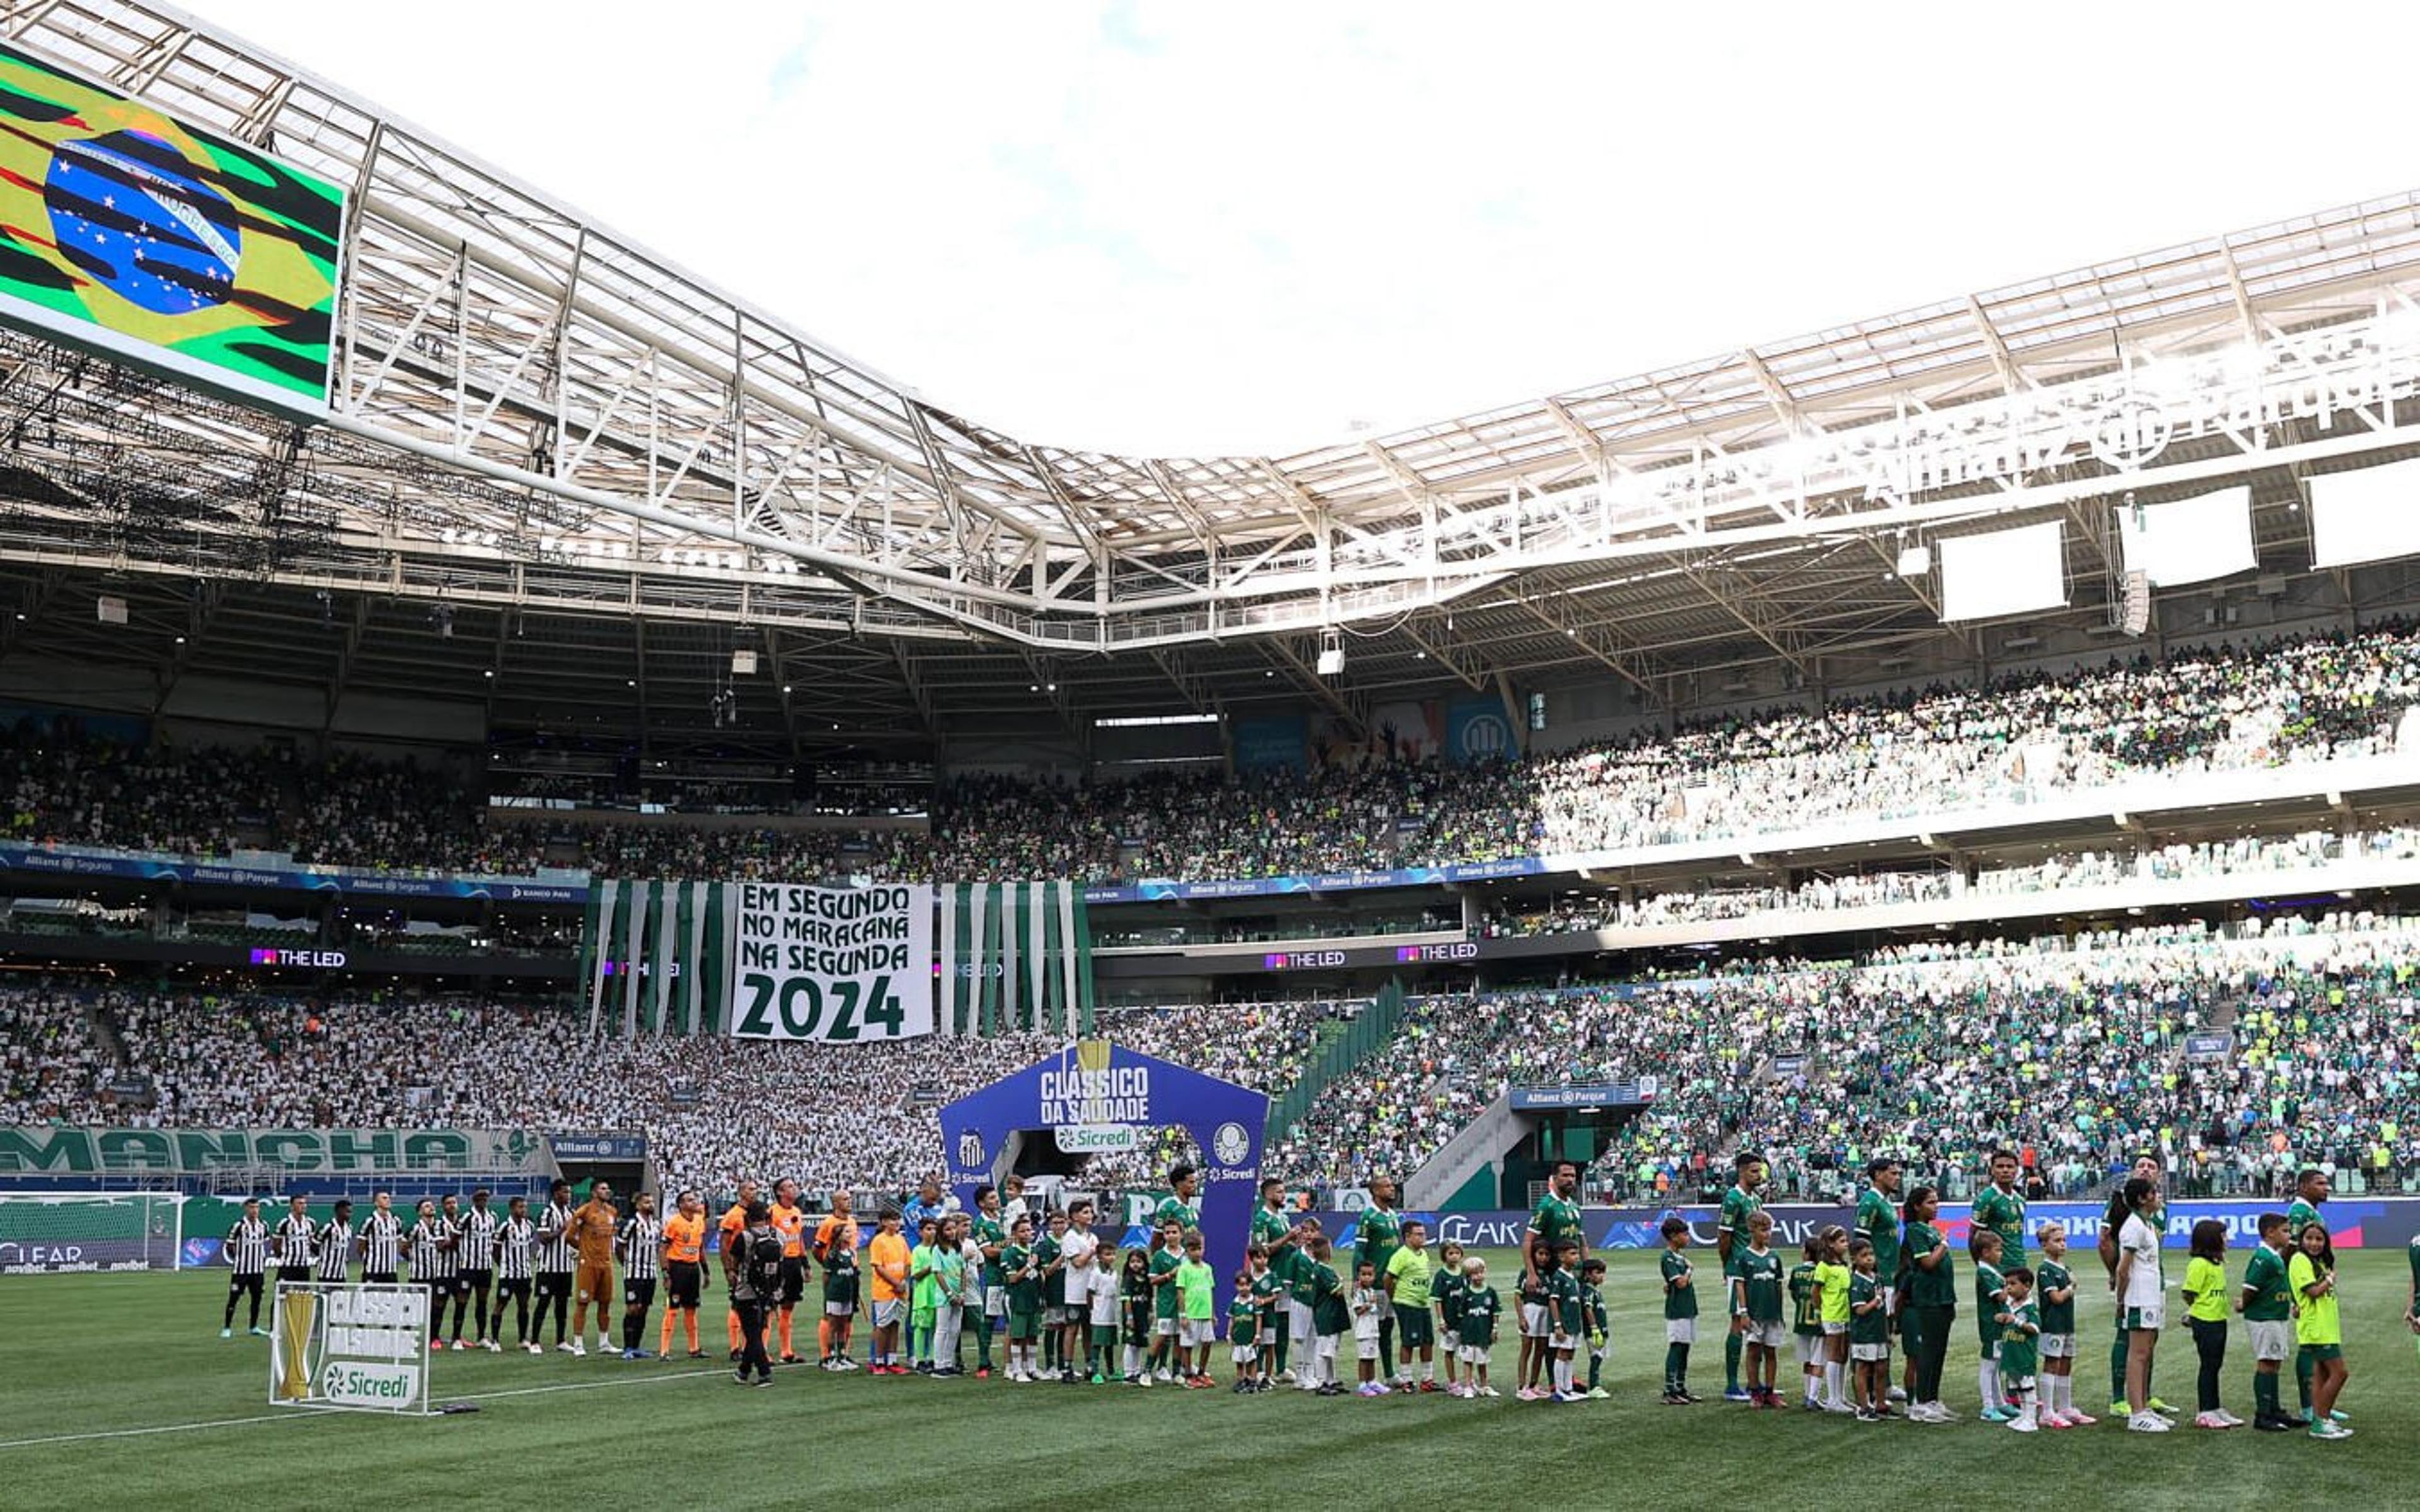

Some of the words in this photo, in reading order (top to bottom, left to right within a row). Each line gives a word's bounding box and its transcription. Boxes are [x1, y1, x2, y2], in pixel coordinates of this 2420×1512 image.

[25, 855, 60, 866] Allianz
[193, 868, 229, 880] Allianz
[743, 885, 779, 912] EM
[788, 888, 909, 920] SEGUNDO
[743, 913, 775, 937] NO
[783, 911, 909, 948] MARACANÃ
[279, 949, 311, 966] THE
[313, 952, 345, 967] LED
[742, 941, 778, 970] NA
[788, 944, 908, 976] SEGUNDA
[1288, 953, 1316, 967] THE
[1318, 952, 1345, 965] LED
[1420, 946, 1448, 959] THE
[1450, 944, 1478, 958] LED
[738, 973, 904, 1040] 2024
[1041, 1064, 1148, 1101] CLÁSSICO
[1527, 1094, 1560, 1103] Allianz
[1576, 1092, 1606, 1101] Parque
[1041, 1101, 1064, 1124] DA
[1077, 1128, 1130, 1146] Sicredi
[0, 1128, 471, 1171] MANCHA
[555, 1142, 595, 1153] Allianz
[1222, 1168, 1255, 1179] Sicredi
[348, 1372, 408, 1399] Sicredi
